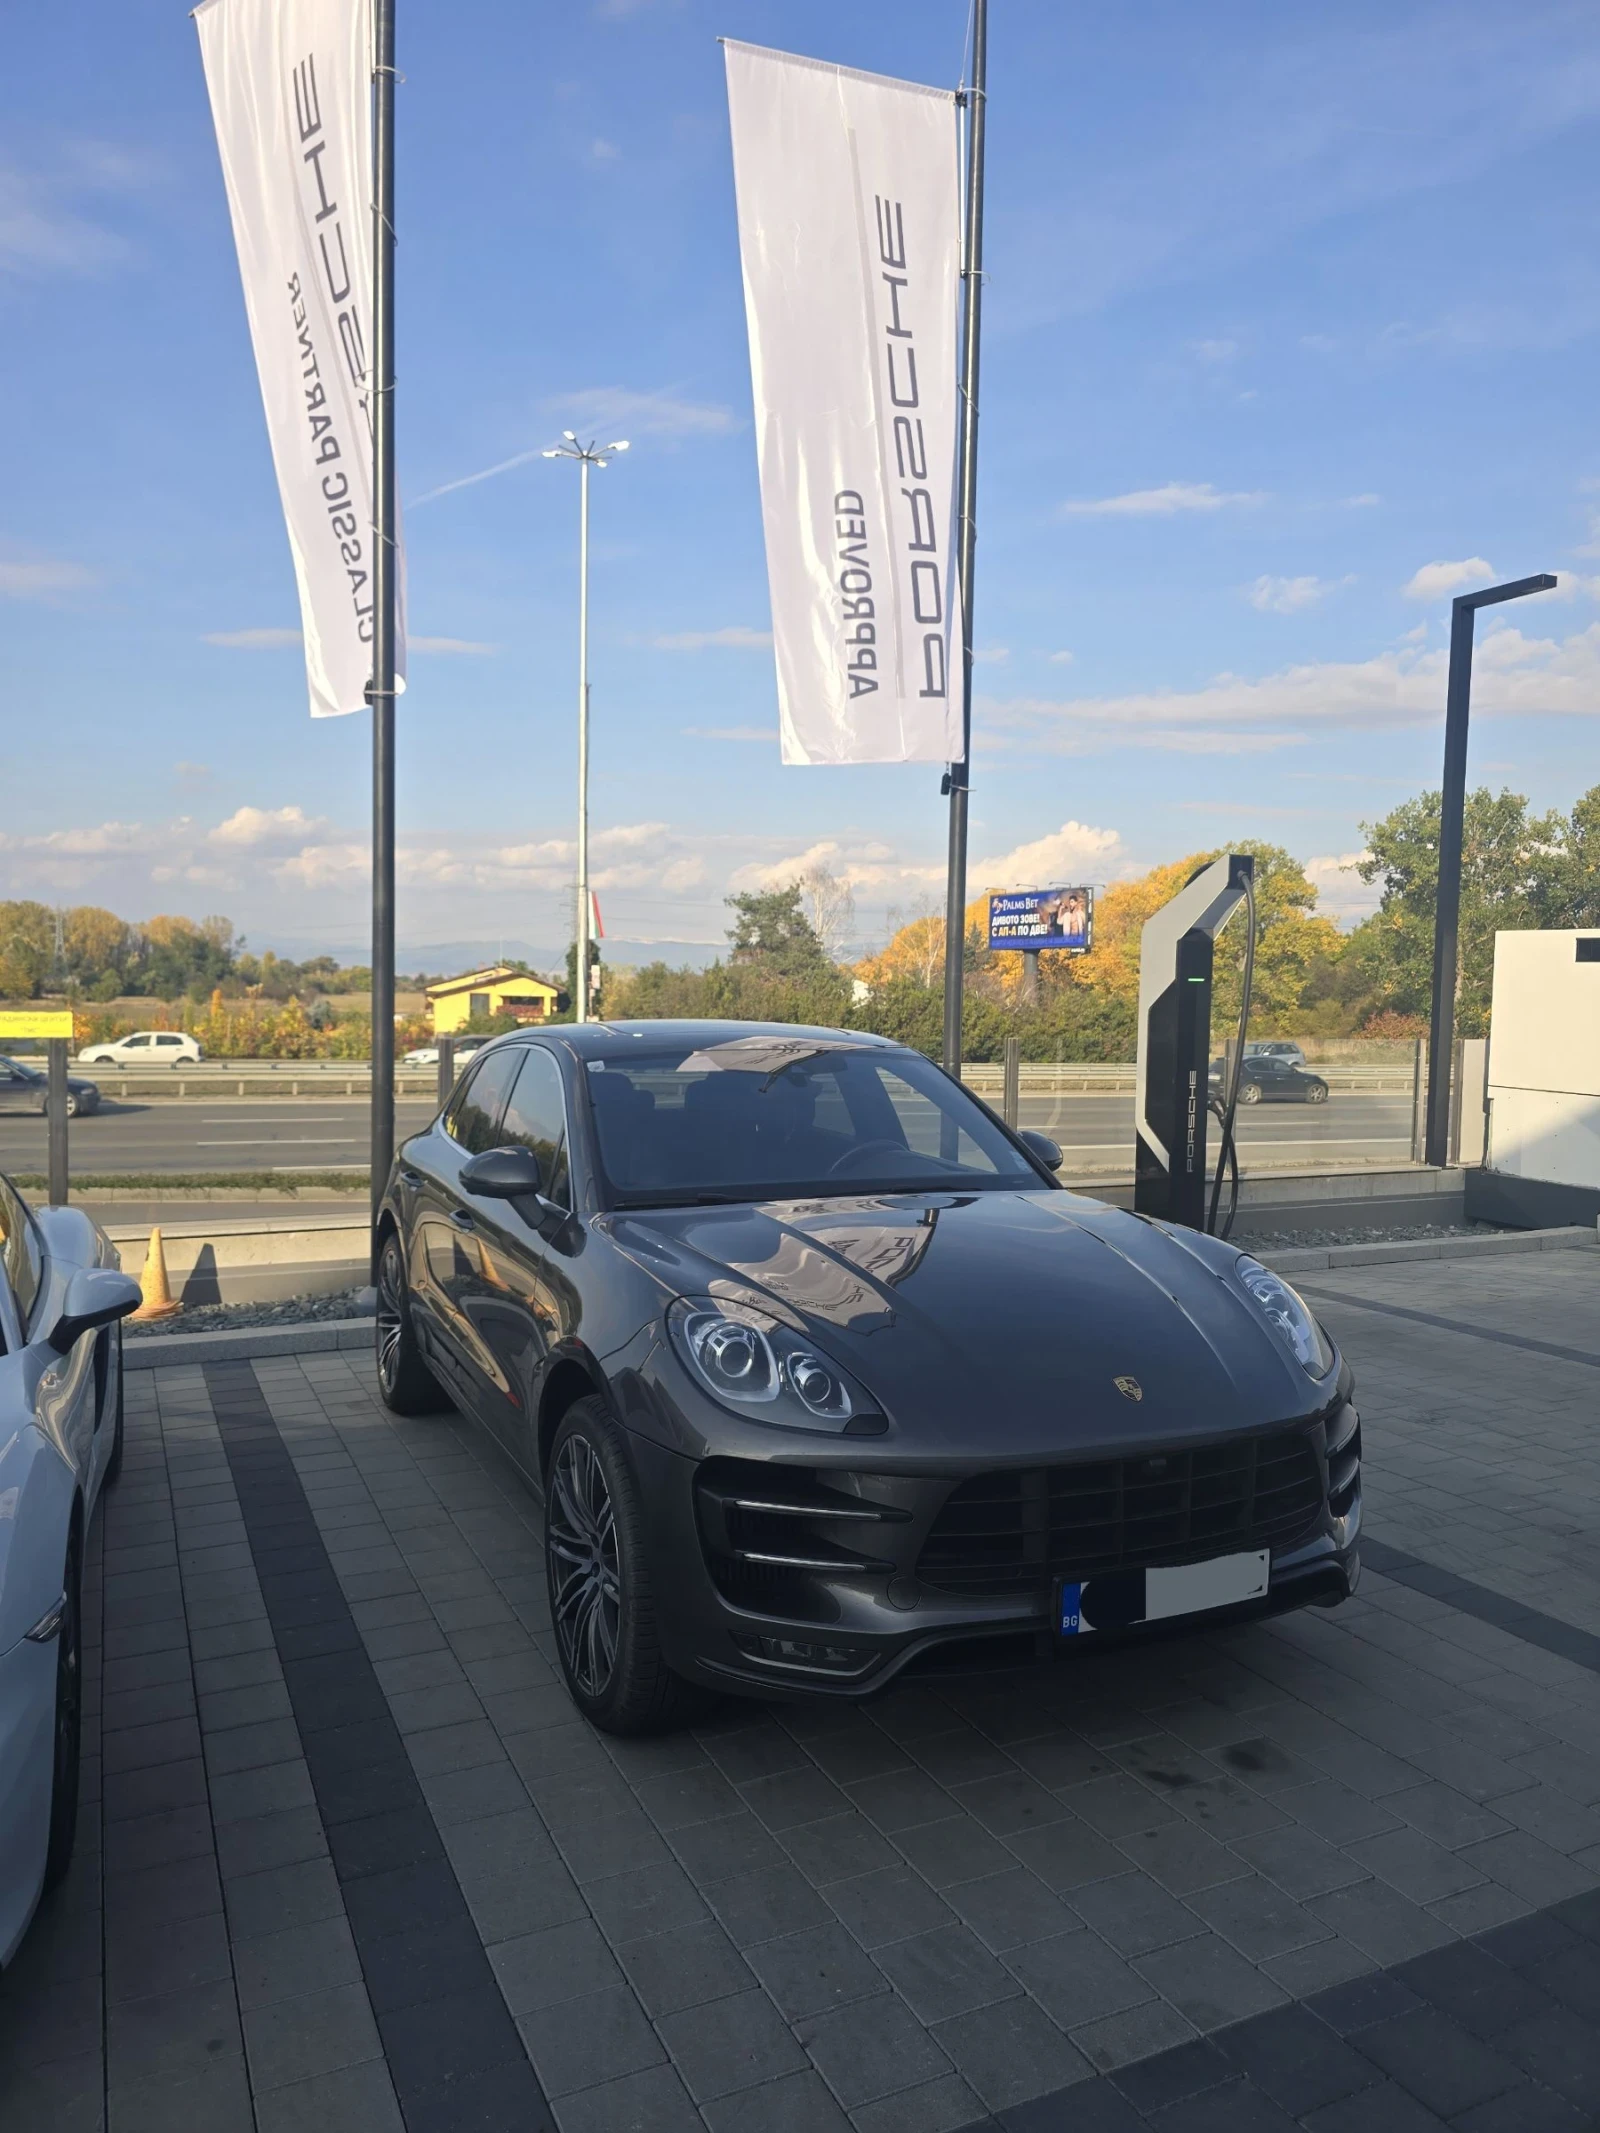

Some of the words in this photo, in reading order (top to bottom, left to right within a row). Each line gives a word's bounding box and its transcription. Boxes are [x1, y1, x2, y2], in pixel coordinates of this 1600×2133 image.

[1003, 899, 1025, 911] PALMS
[1025, 897, 1039, 909] BET
[992, 914, 1019, 926] ДИВОТО
[1018, 925, 1029, 936] ПО
[1030, 924, 1048, 937] ДВЕ!
[1187, 1070, 1197, 1173] PORSCHE
[1062, 1615, 1078, 1628] BG
